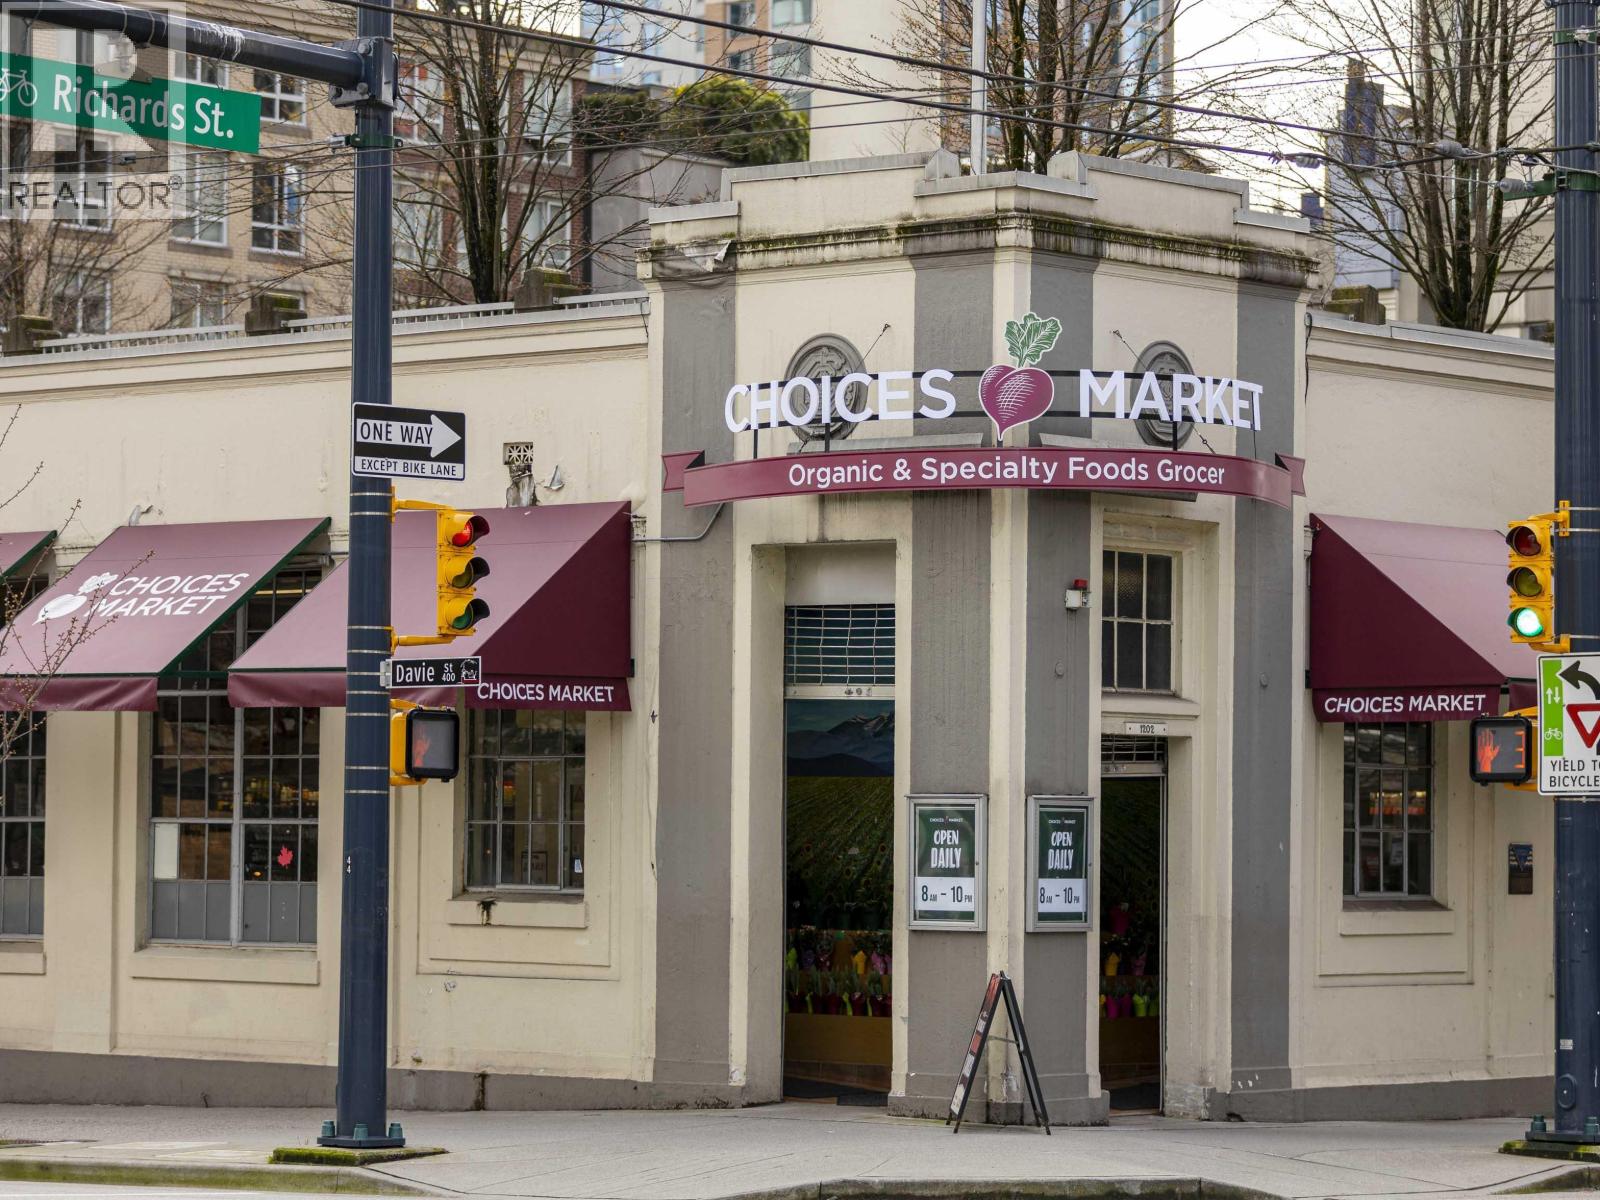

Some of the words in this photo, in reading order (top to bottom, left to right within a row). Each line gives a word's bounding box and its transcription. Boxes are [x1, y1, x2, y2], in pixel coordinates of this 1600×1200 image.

[53, 73, 186, 131] Richards
[193, 97, 234, 139] St.
[724, 368, 957, 433] CHOICES
[1079, 368, 1264, 432] MARKET
[360, 421, 393, 442] ONE
[400, 424, 433, 445] WAY
[361, 458, 399, 472] EXCEPT
[402, 461, 426, 474] BIKE
[430, 463, 457, 476] LANE
[788, 459, 884, 489] Organic
[892, 458, 912, 481] &
[921, 455, 1059, 484] Specialty
[1068, 456, 1149, 482] Foods
[1156, 458, 1225, 485] Grocer
[109, 572, 250, 596] CHOICES
[84, 595, 227, 617] MARKET
[396, 662, 435, 683] Davie
[443, 662, 453, 673] St
[441, 673, 456, 683] 400
[477, 682, 545, 701] CHOICES
[549, 684, 614, 703] MARKET
[1324, 695, 1404, 714] CHOICES
[1408, 694, 1486, 712] MARKET
[1140, 724, 1155, 734] 1202
[1550, 759, 1585, 772] YIELD
[1591, 759, 1600, 772] T
[933, 829, 959, 845] OPEN
[1051, 831, 1073, 847] OPEN
[930, 847, 962, 869] DAILY
[1048, 848, 1074, 871] DAILY
